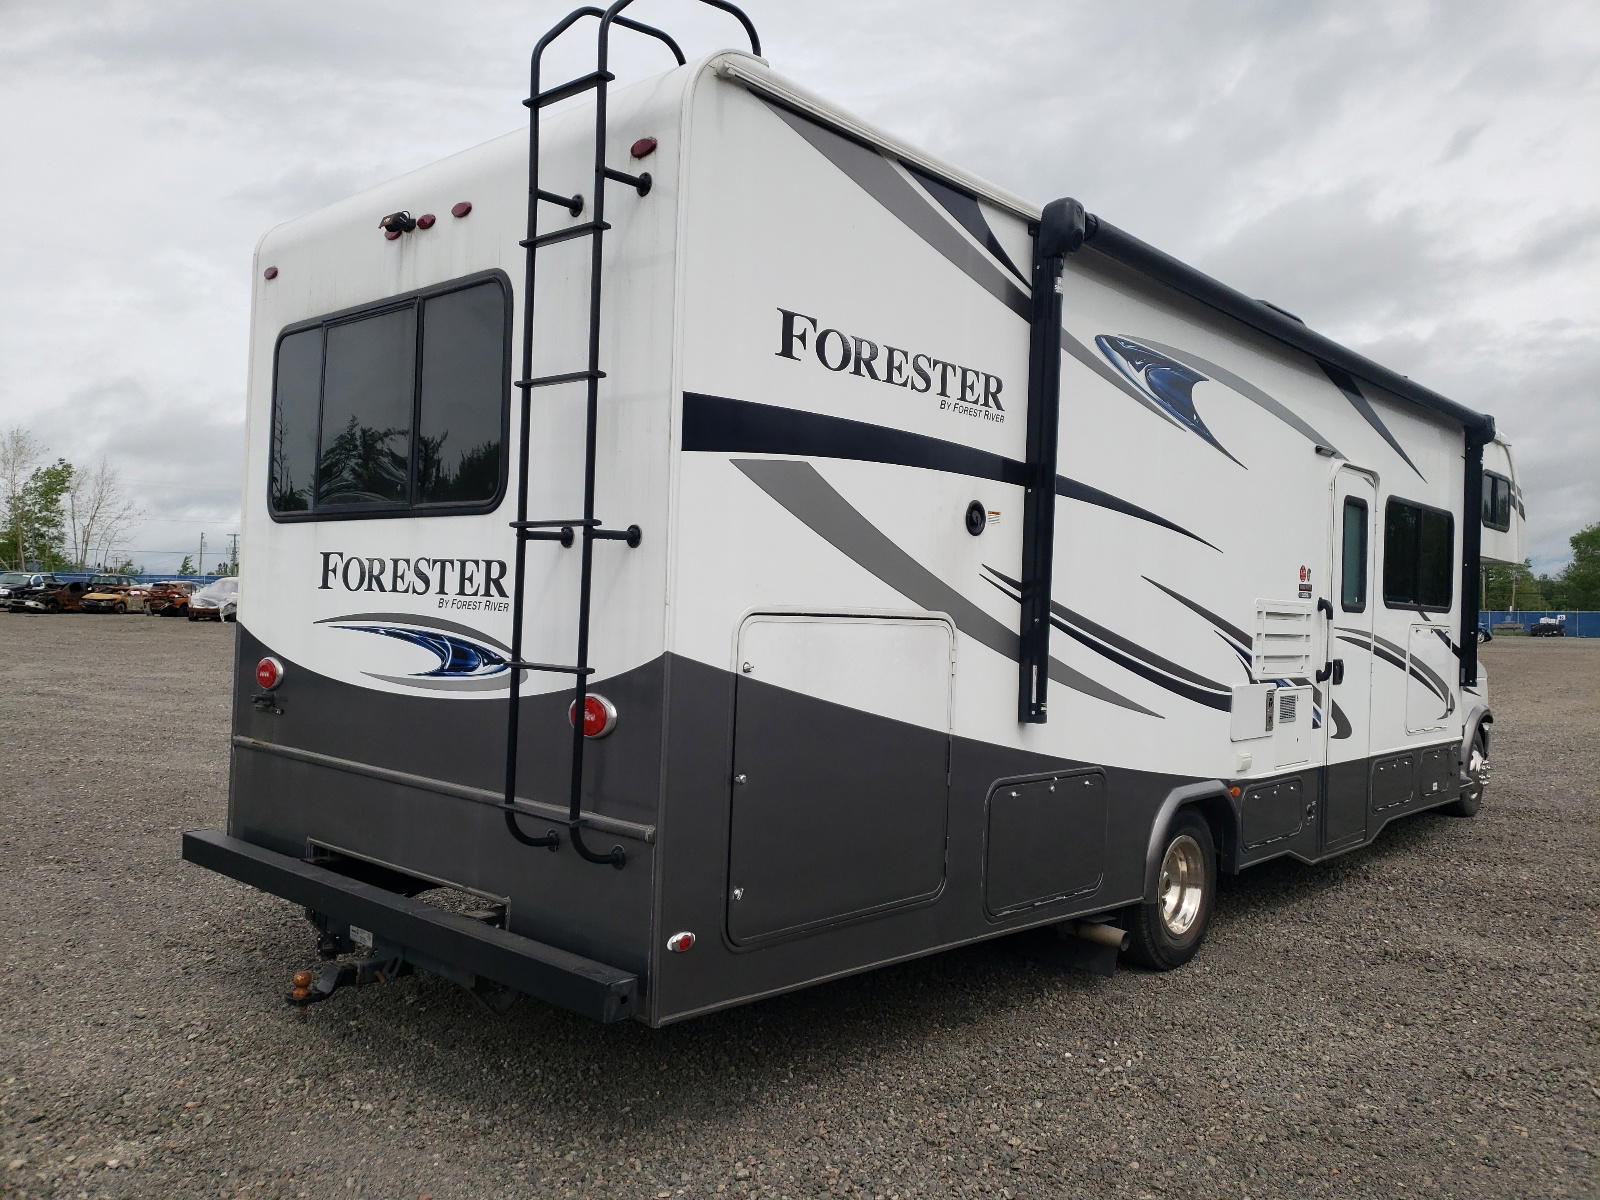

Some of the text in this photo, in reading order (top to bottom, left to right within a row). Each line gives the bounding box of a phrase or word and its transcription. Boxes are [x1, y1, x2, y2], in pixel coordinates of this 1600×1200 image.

[775, 307, 1005, 411] FORESTER
[939, 399, 1005, 423] BY FOREST RIVER
[318, 551, 509, 598] FORESTER
[438, 598, 509, 612] BY FOREST RIVER
